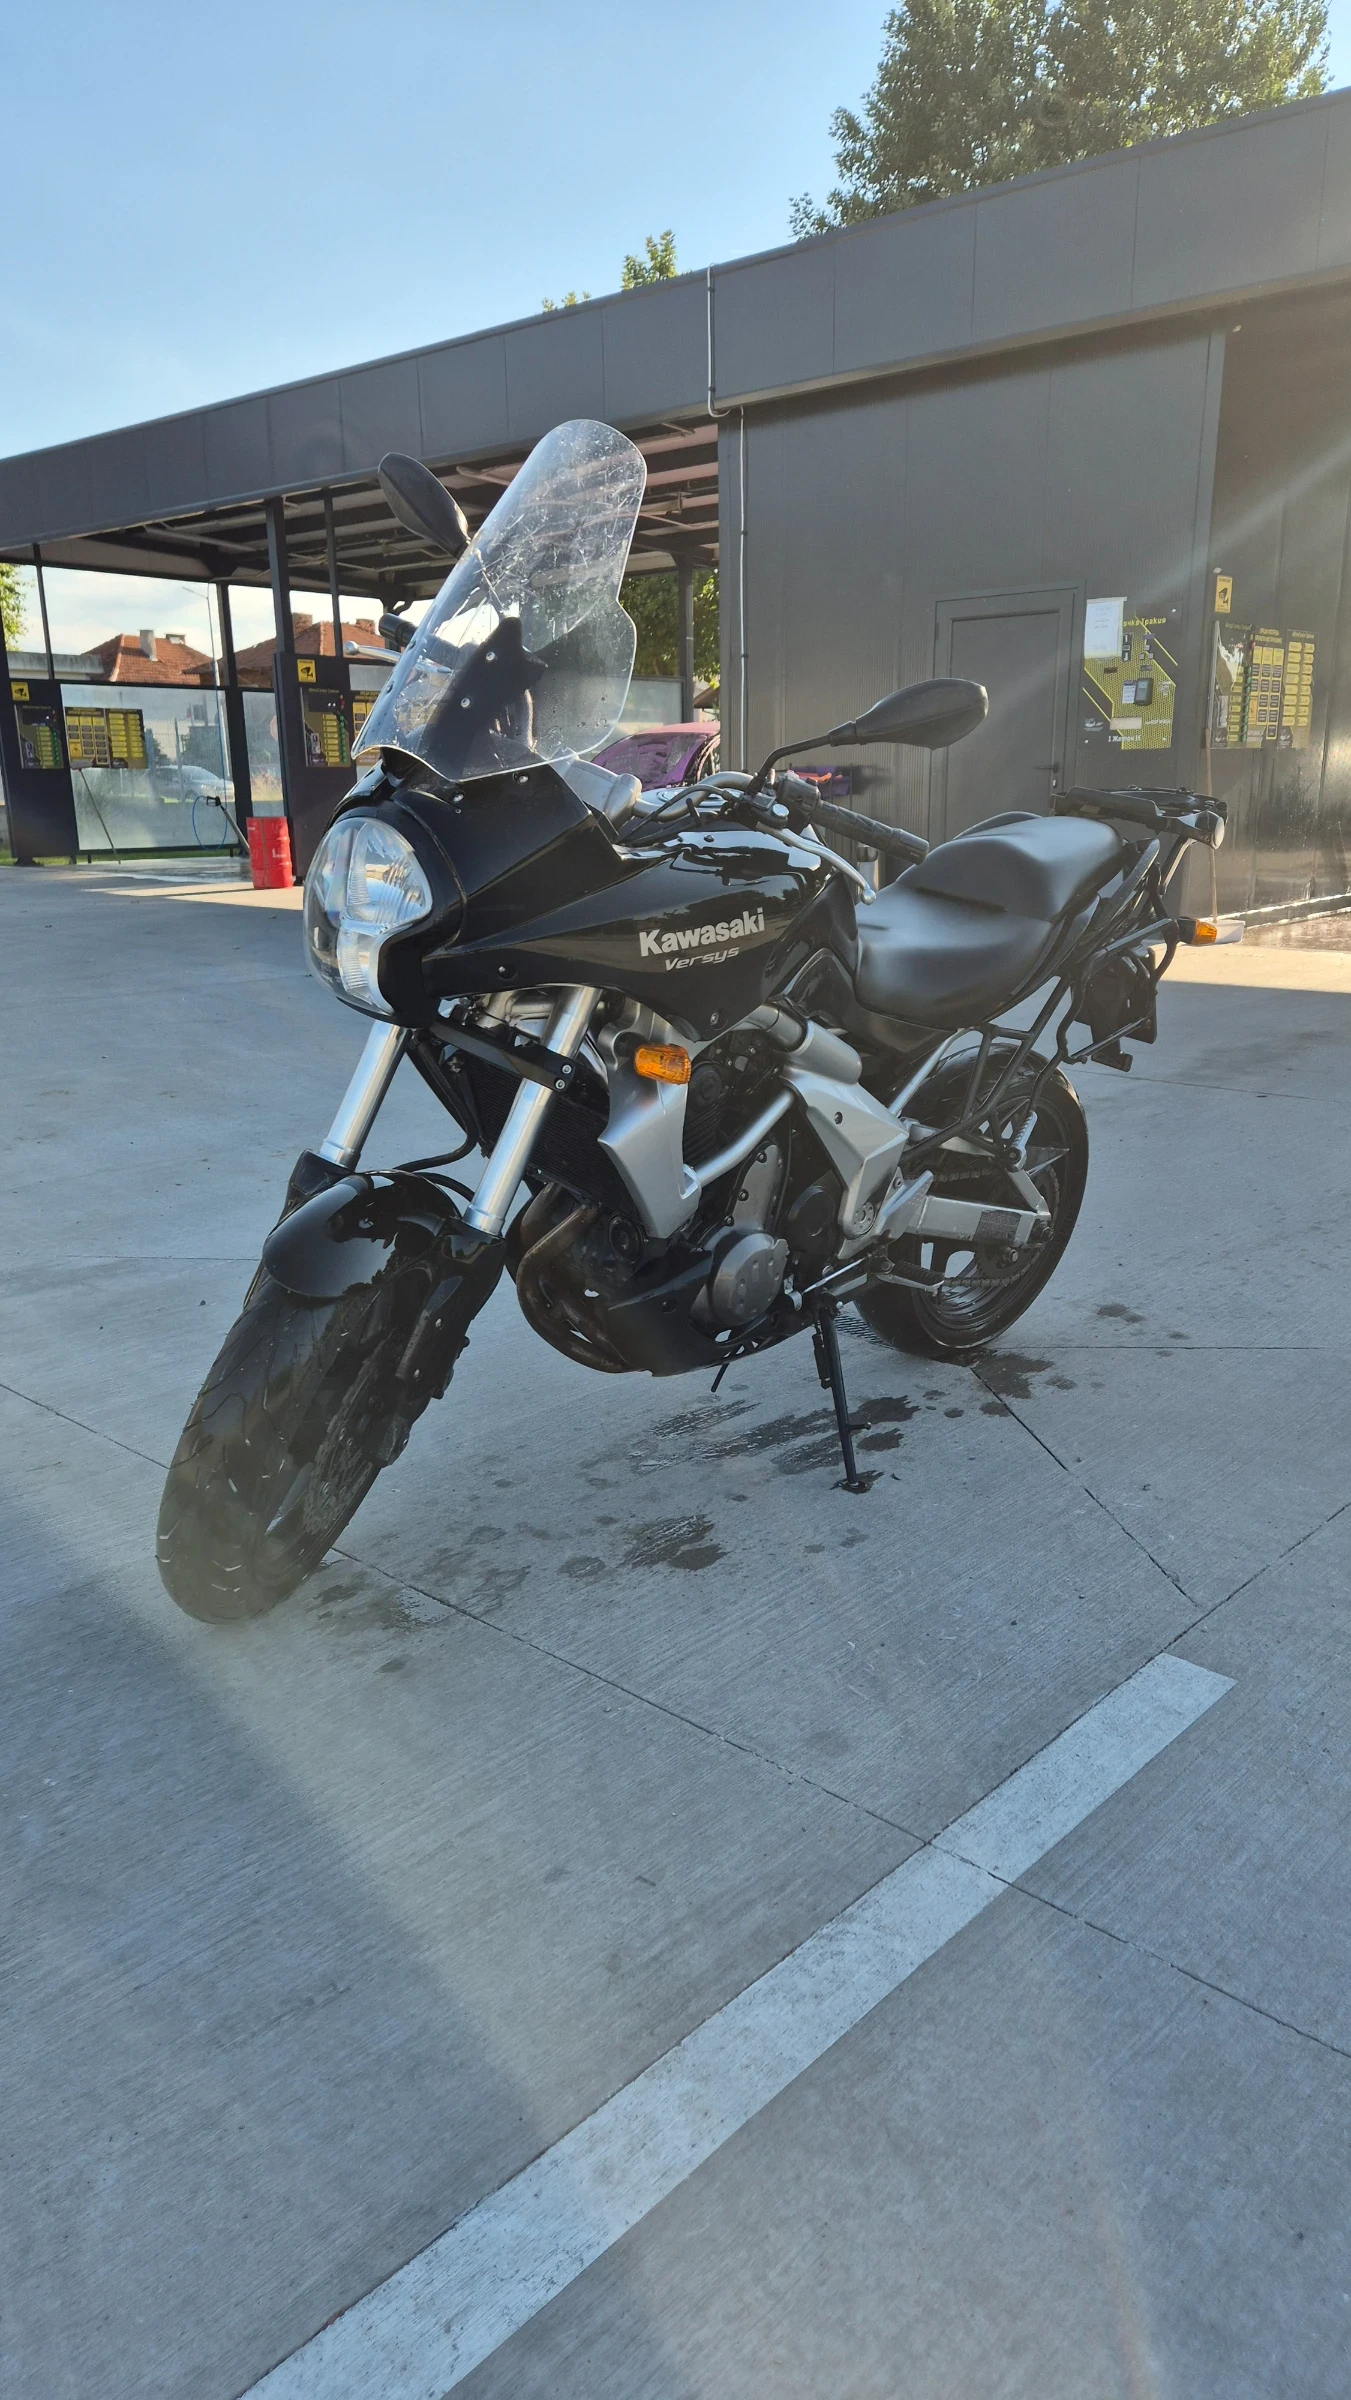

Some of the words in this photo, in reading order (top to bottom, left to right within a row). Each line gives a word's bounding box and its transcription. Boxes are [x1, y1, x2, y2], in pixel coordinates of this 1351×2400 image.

[1141, 617, 1167, 626] Тракия
[639, 907, 765, 957] Kawasaki
[665, 947, 740, 971] Versys
